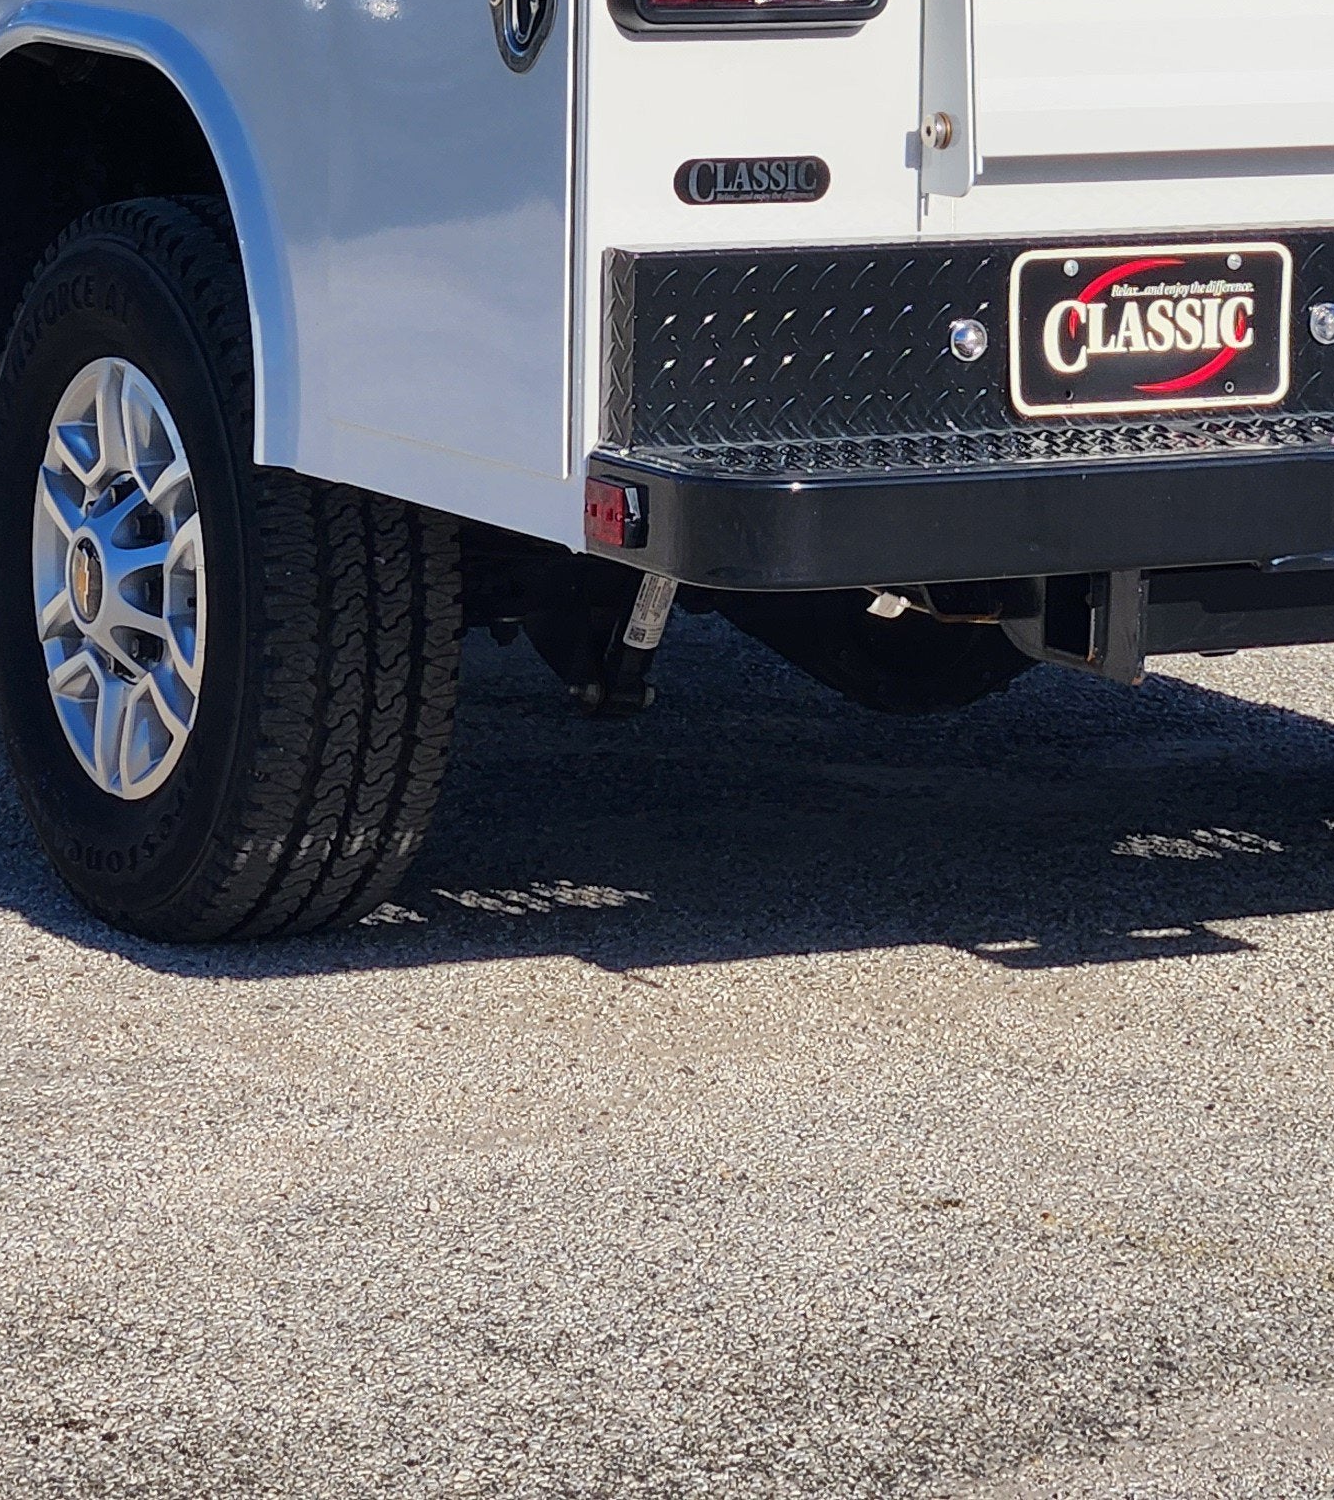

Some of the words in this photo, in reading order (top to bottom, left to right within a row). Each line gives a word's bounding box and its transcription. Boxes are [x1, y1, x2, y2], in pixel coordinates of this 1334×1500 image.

[688, 159, 817, 203] CLASSIC
[1164, 281, 1190, 298] enjoy
[1190, 280, 1206, 294] the
[1043, 296, 1255, 373] CLASSIC
